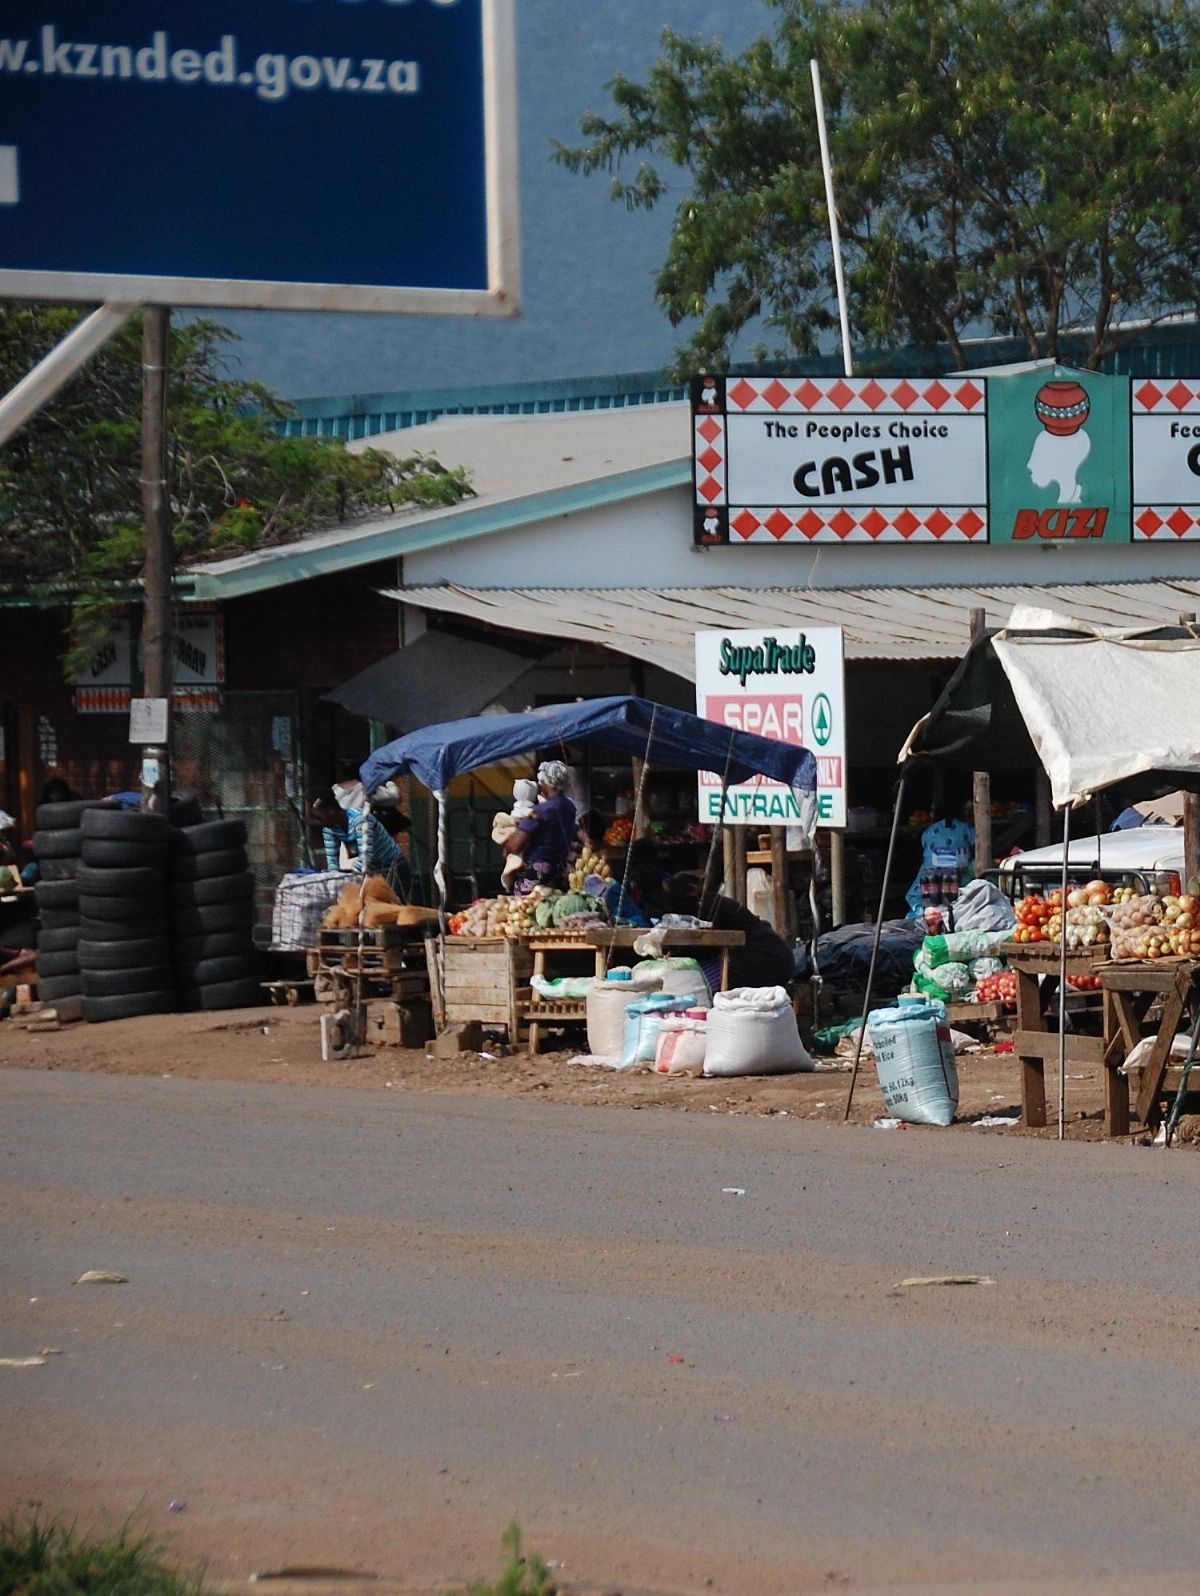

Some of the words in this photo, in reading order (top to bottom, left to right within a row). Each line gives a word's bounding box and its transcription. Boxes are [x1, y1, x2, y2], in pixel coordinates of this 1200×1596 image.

[764, 421, 798, 439] The
[807, 421, 880, 442] Peoples
[889, 420, 949, 439] Choice
[793, 445, 914, 497] CASH
[1011, 507, 1109, 539] BUZI
[719, 633, 815, 686] SupaTrade
[724, 702, 802, 739] SPAR
[709, 792, 833, 819] ENTRANE
